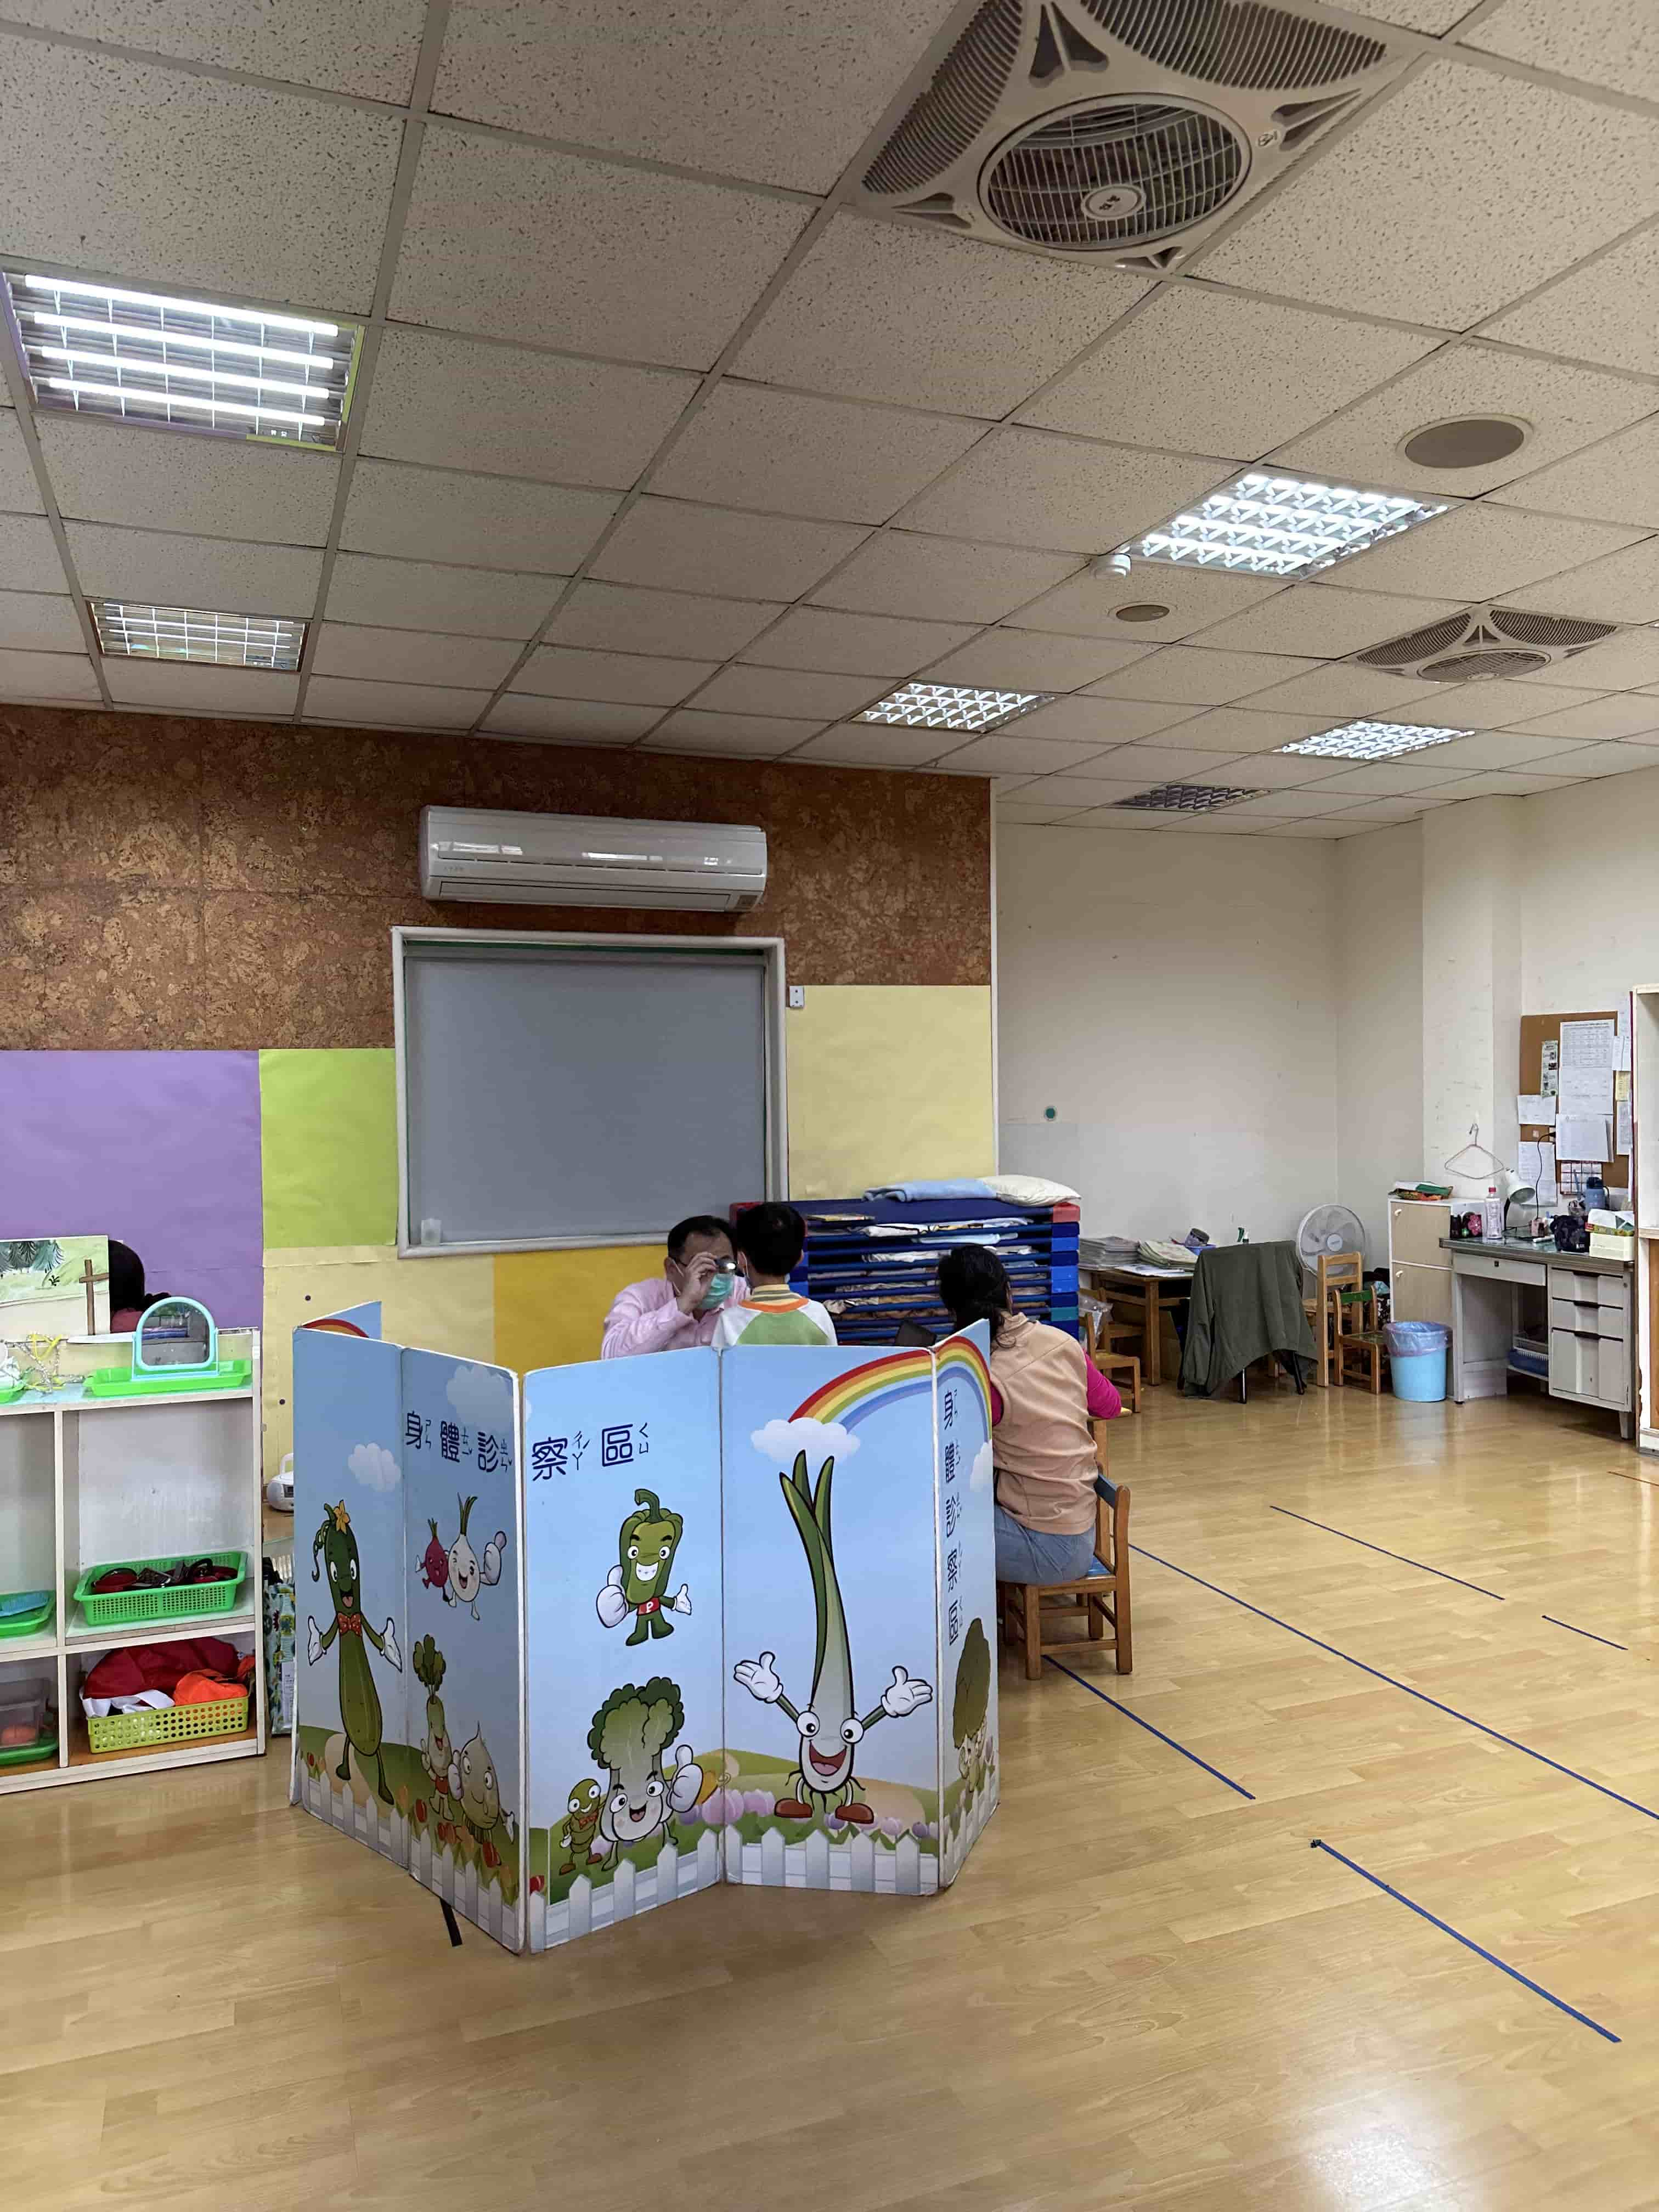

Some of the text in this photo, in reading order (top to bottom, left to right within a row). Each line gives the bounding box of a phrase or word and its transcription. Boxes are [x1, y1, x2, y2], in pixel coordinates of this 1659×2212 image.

[944, 1390, 959, 1646] 身體診察區
